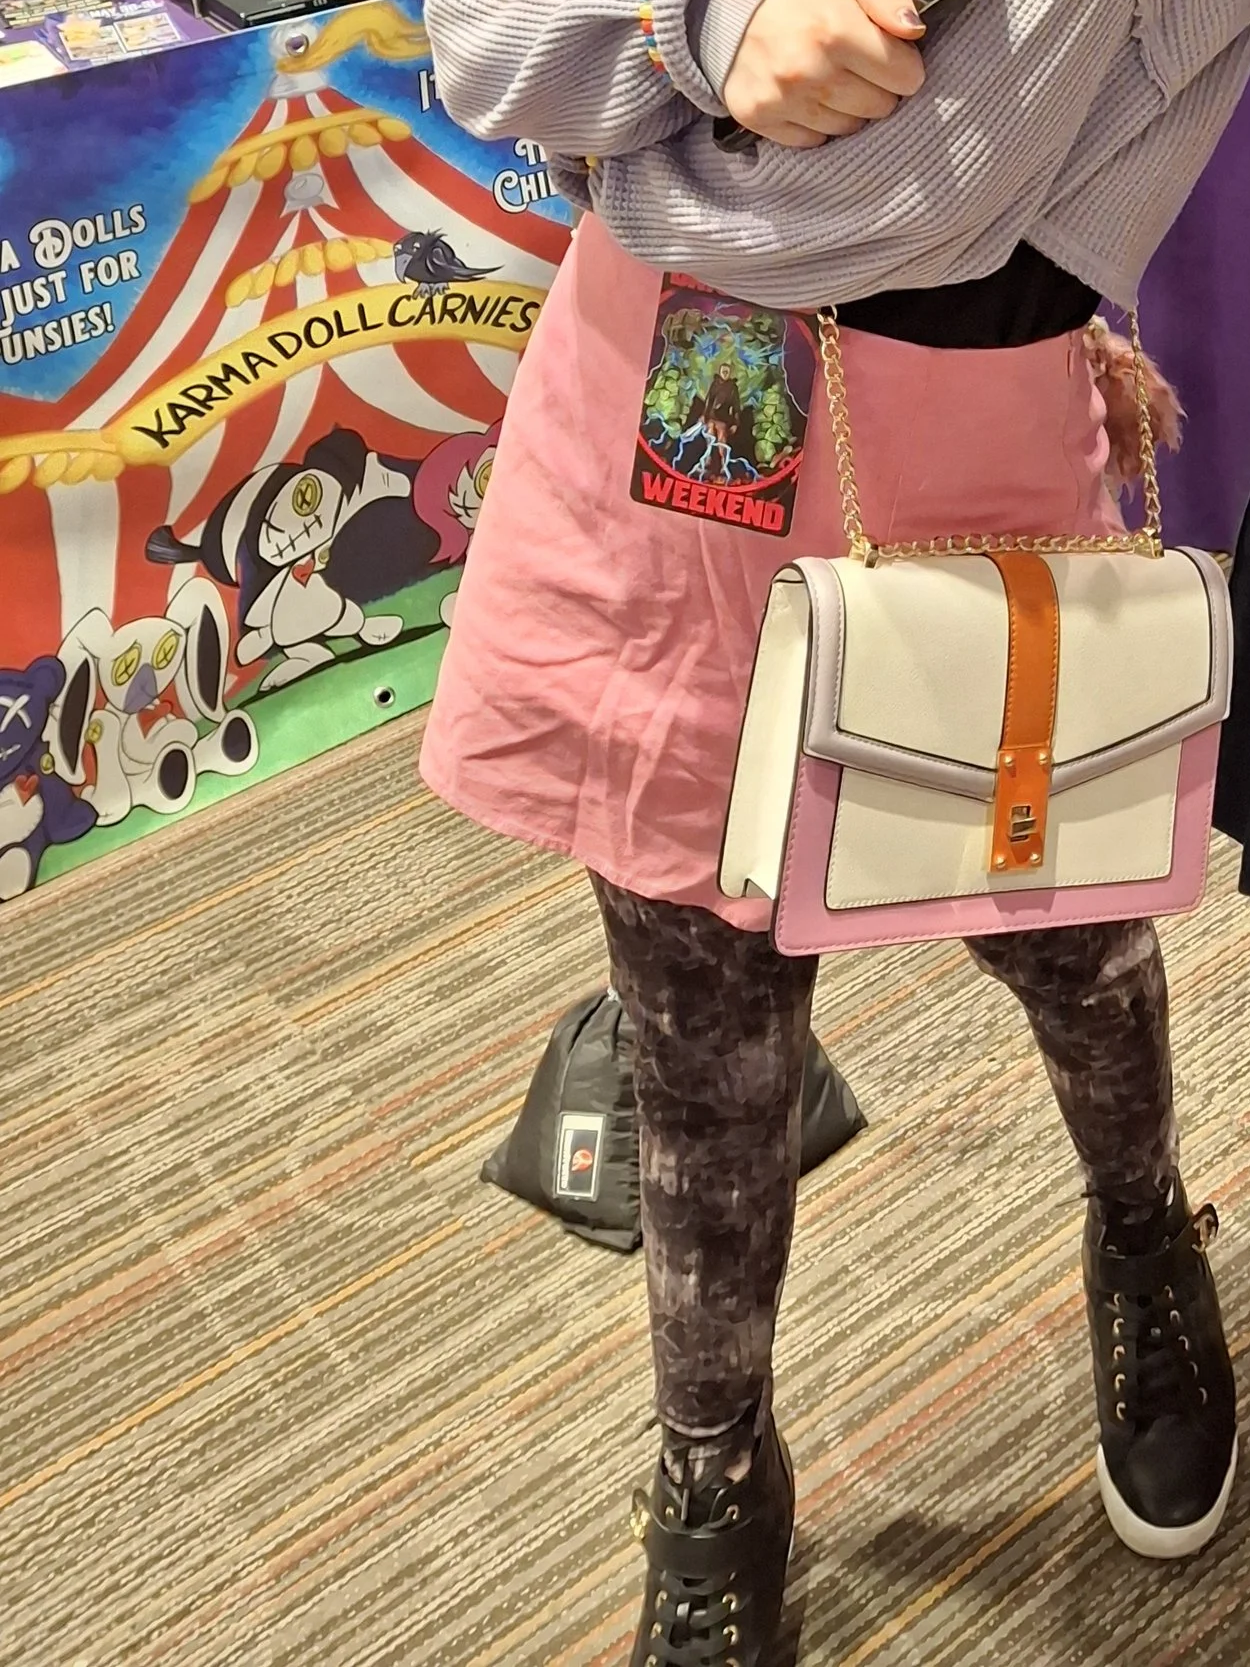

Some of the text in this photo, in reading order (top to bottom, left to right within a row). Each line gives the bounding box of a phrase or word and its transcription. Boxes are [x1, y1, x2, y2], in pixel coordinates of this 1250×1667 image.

[28, 203, 147, 270] DOLLS
[0, 271, 67, 328] JUST
[79, 249, 142, 294] FOR
[132, 292, 541, 448] KARMA DOLL CARNIES
[641, 470, 785, 532] WEEKEND
